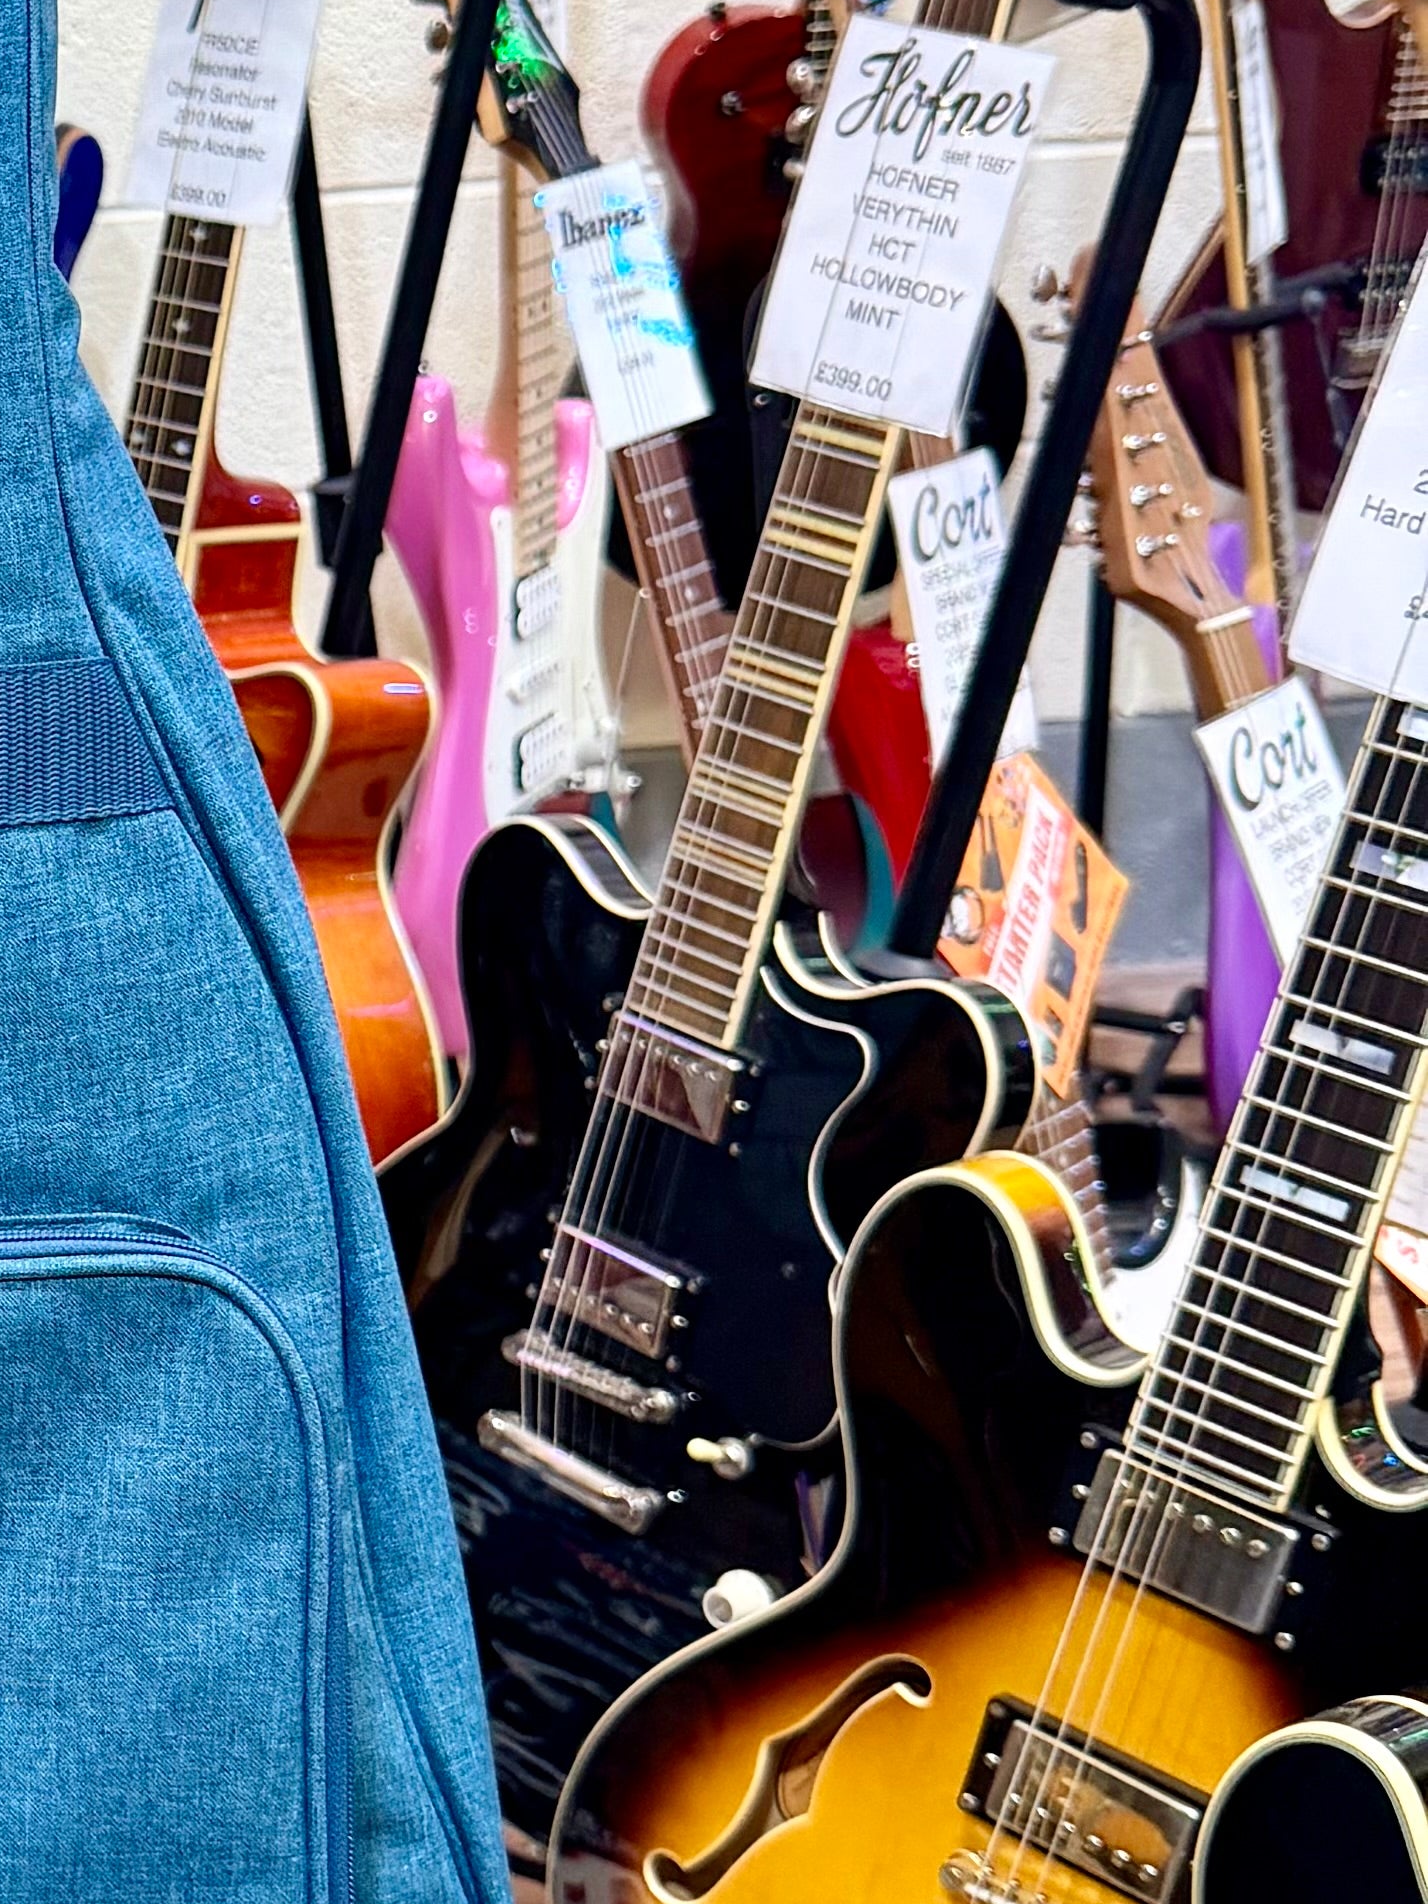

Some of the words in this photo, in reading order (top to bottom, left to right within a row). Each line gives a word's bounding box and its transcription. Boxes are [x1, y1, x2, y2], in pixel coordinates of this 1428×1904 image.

[868, 161, 959, 202] HOFNER
[559, 206, 645, 247] Ibanez
[852, 193, 959, 239] VERYTHIN
[868, 233, 916, 263] HCT
[810, 254, 964, 311] HOLLOWBODY
[845, 299, 900, 330] MINT
[814, 361, 893, 401] £399.00
[911, 472, 992, 563] Cort
[1360, 494, 1425, 534] Hard
[1228, 701, 1317, 813] Cort
